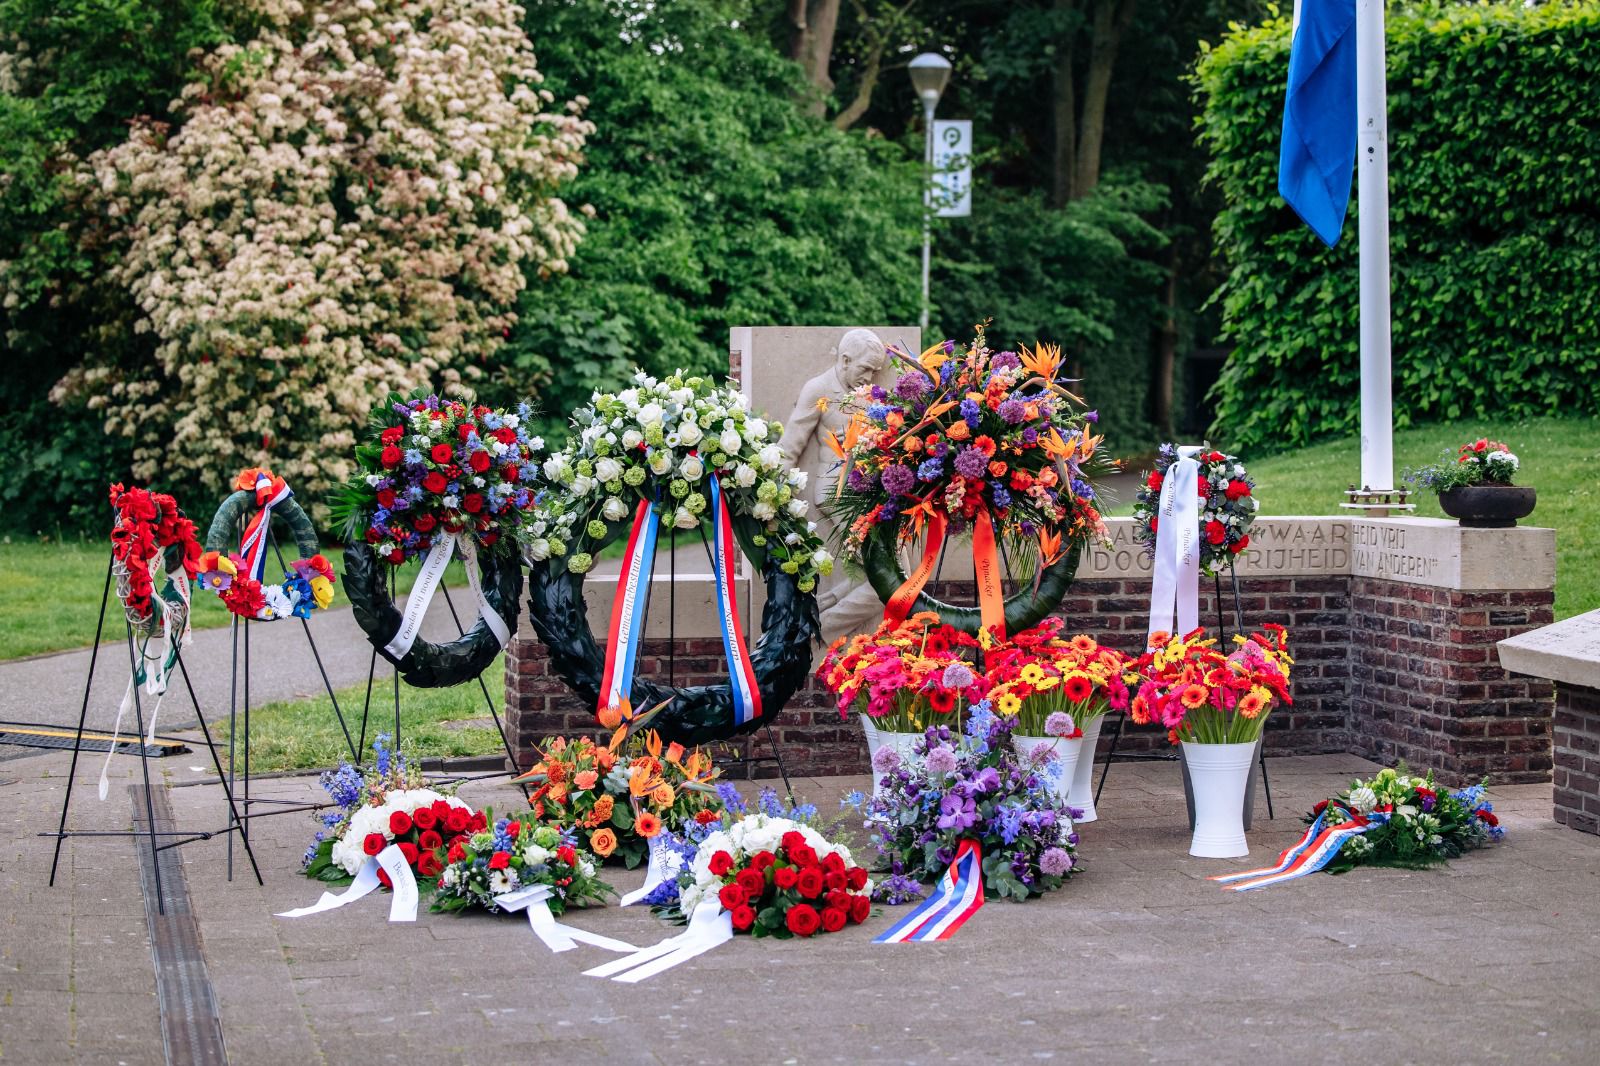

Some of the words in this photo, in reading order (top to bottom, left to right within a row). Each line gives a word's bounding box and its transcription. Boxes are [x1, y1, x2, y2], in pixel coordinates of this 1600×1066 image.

[1352, 524, 1378, 546] HEID
[1381, 526, 1406, 549] VRIJ
[1241, 548, 1348, 569] RIJHEID
[1352, 549, 1375, 571] VAN
[981, 558, 994, 598] Pijnacker
[619, 551, 642, 645] Gemeentebestuur
[725, 608, 739, 661] Nootdorp
